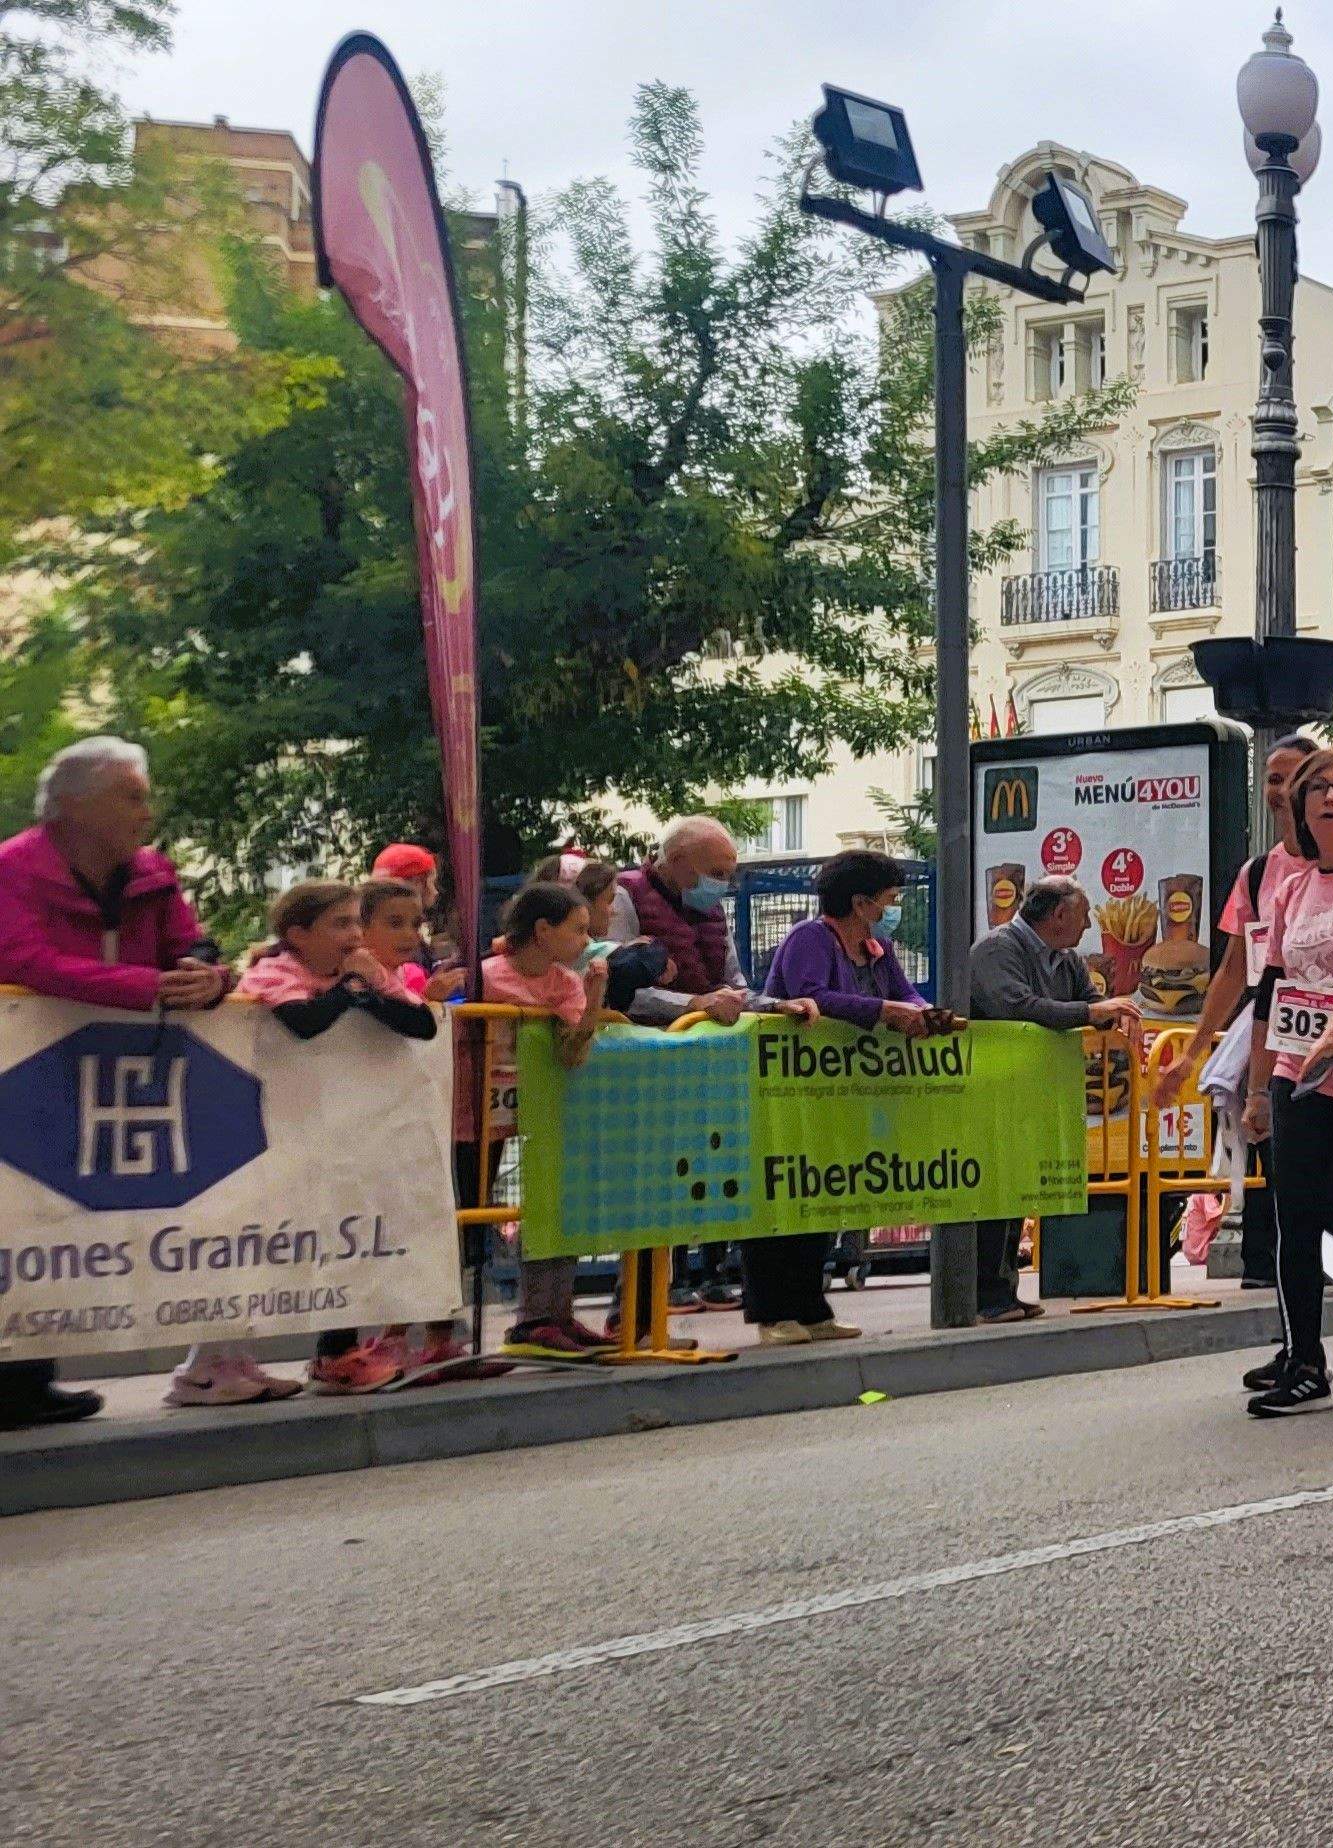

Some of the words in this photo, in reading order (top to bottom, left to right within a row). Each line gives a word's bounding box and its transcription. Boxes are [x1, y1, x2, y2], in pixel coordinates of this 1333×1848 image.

[1068, 735, 1111, 747] URBAN
[1074, 776, 1136, 806] MENÚ
[1139, 777, 1200, 801] 4YOU
[1277, 1006, 1329, 1040] 303
[763, 1147, 981, 1201] FiberStudio
[337, 1214, 408, 1261] S.L.
[3, 1302, 136, 1339] ASFALTOS
[155, 1294, 243, 1327] OBRAS
[248, 1284, 350, 1318] PÚBLICAS
